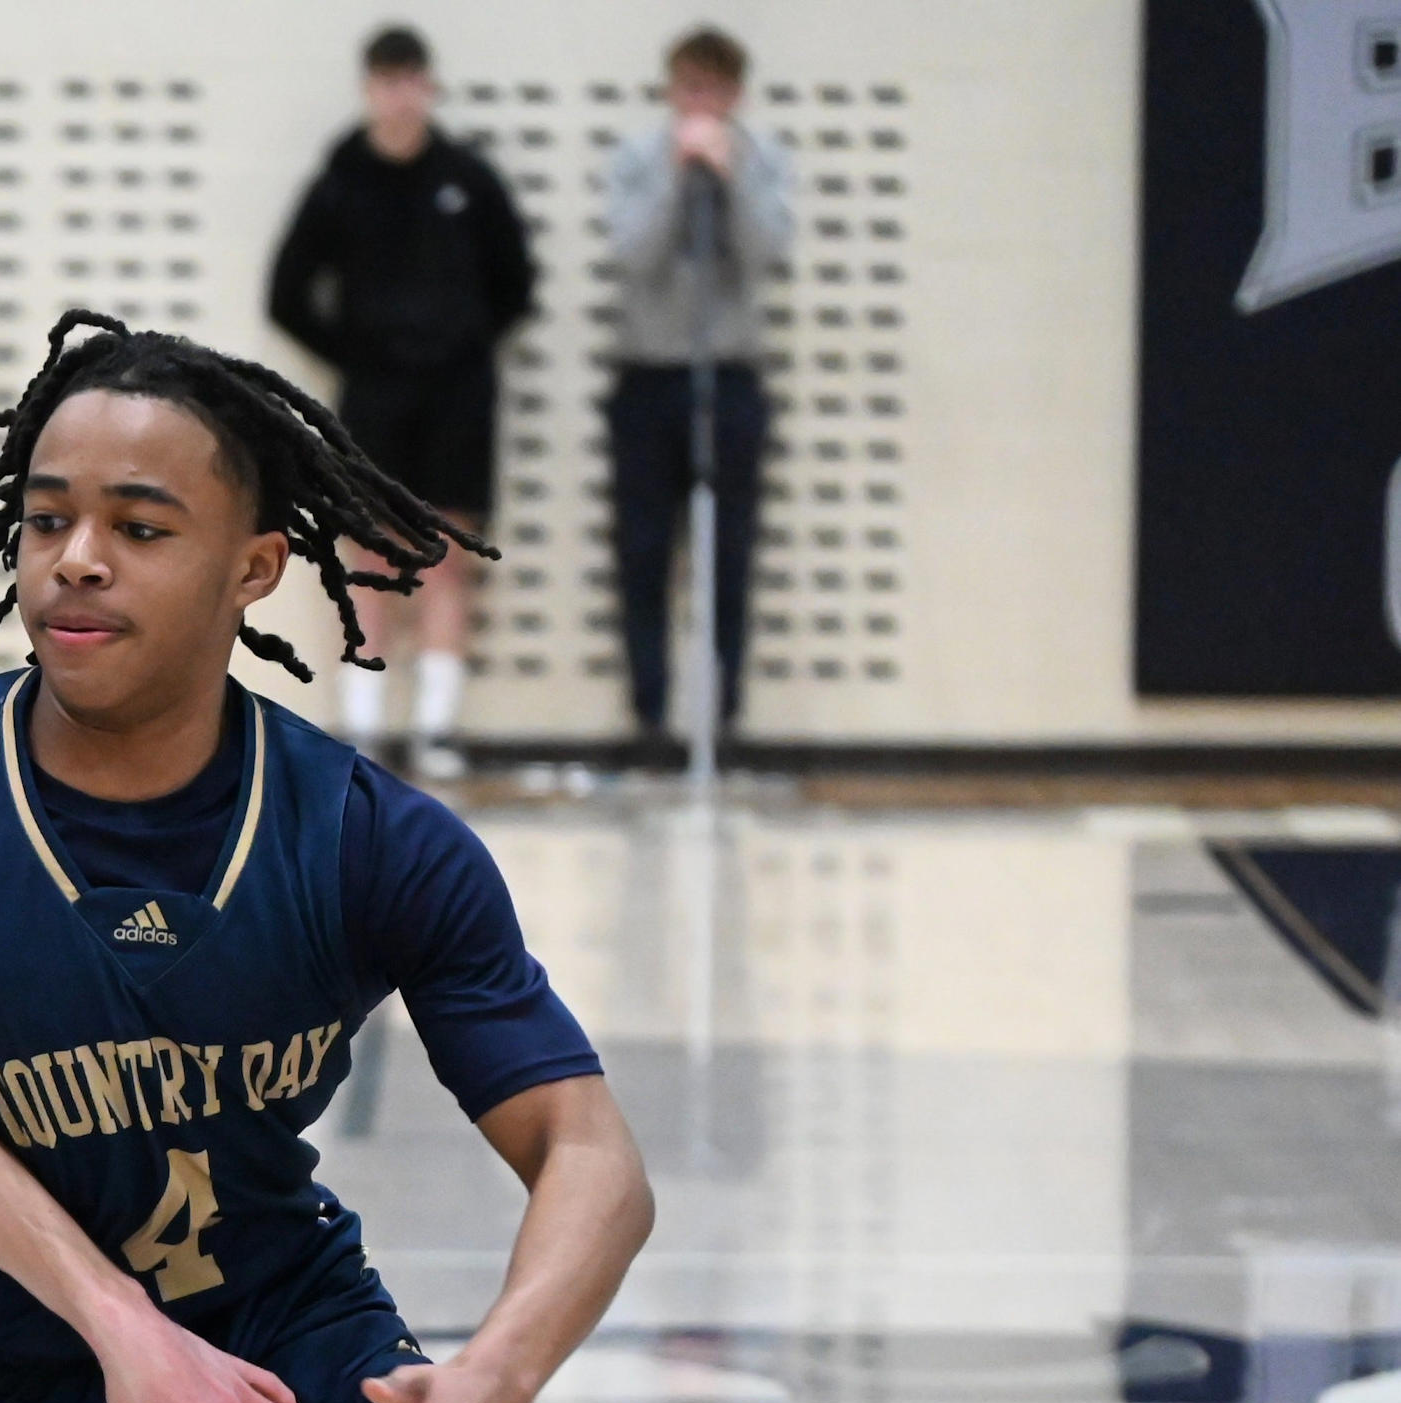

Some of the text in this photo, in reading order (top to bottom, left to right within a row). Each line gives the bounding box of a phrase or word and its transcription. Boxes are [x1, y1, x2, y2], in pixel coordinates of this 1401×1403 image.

[112, 926, 179, 946] adidas
[240, 1020, 342, 1111] DAY
[120, 1148, 225, 1303] 4
